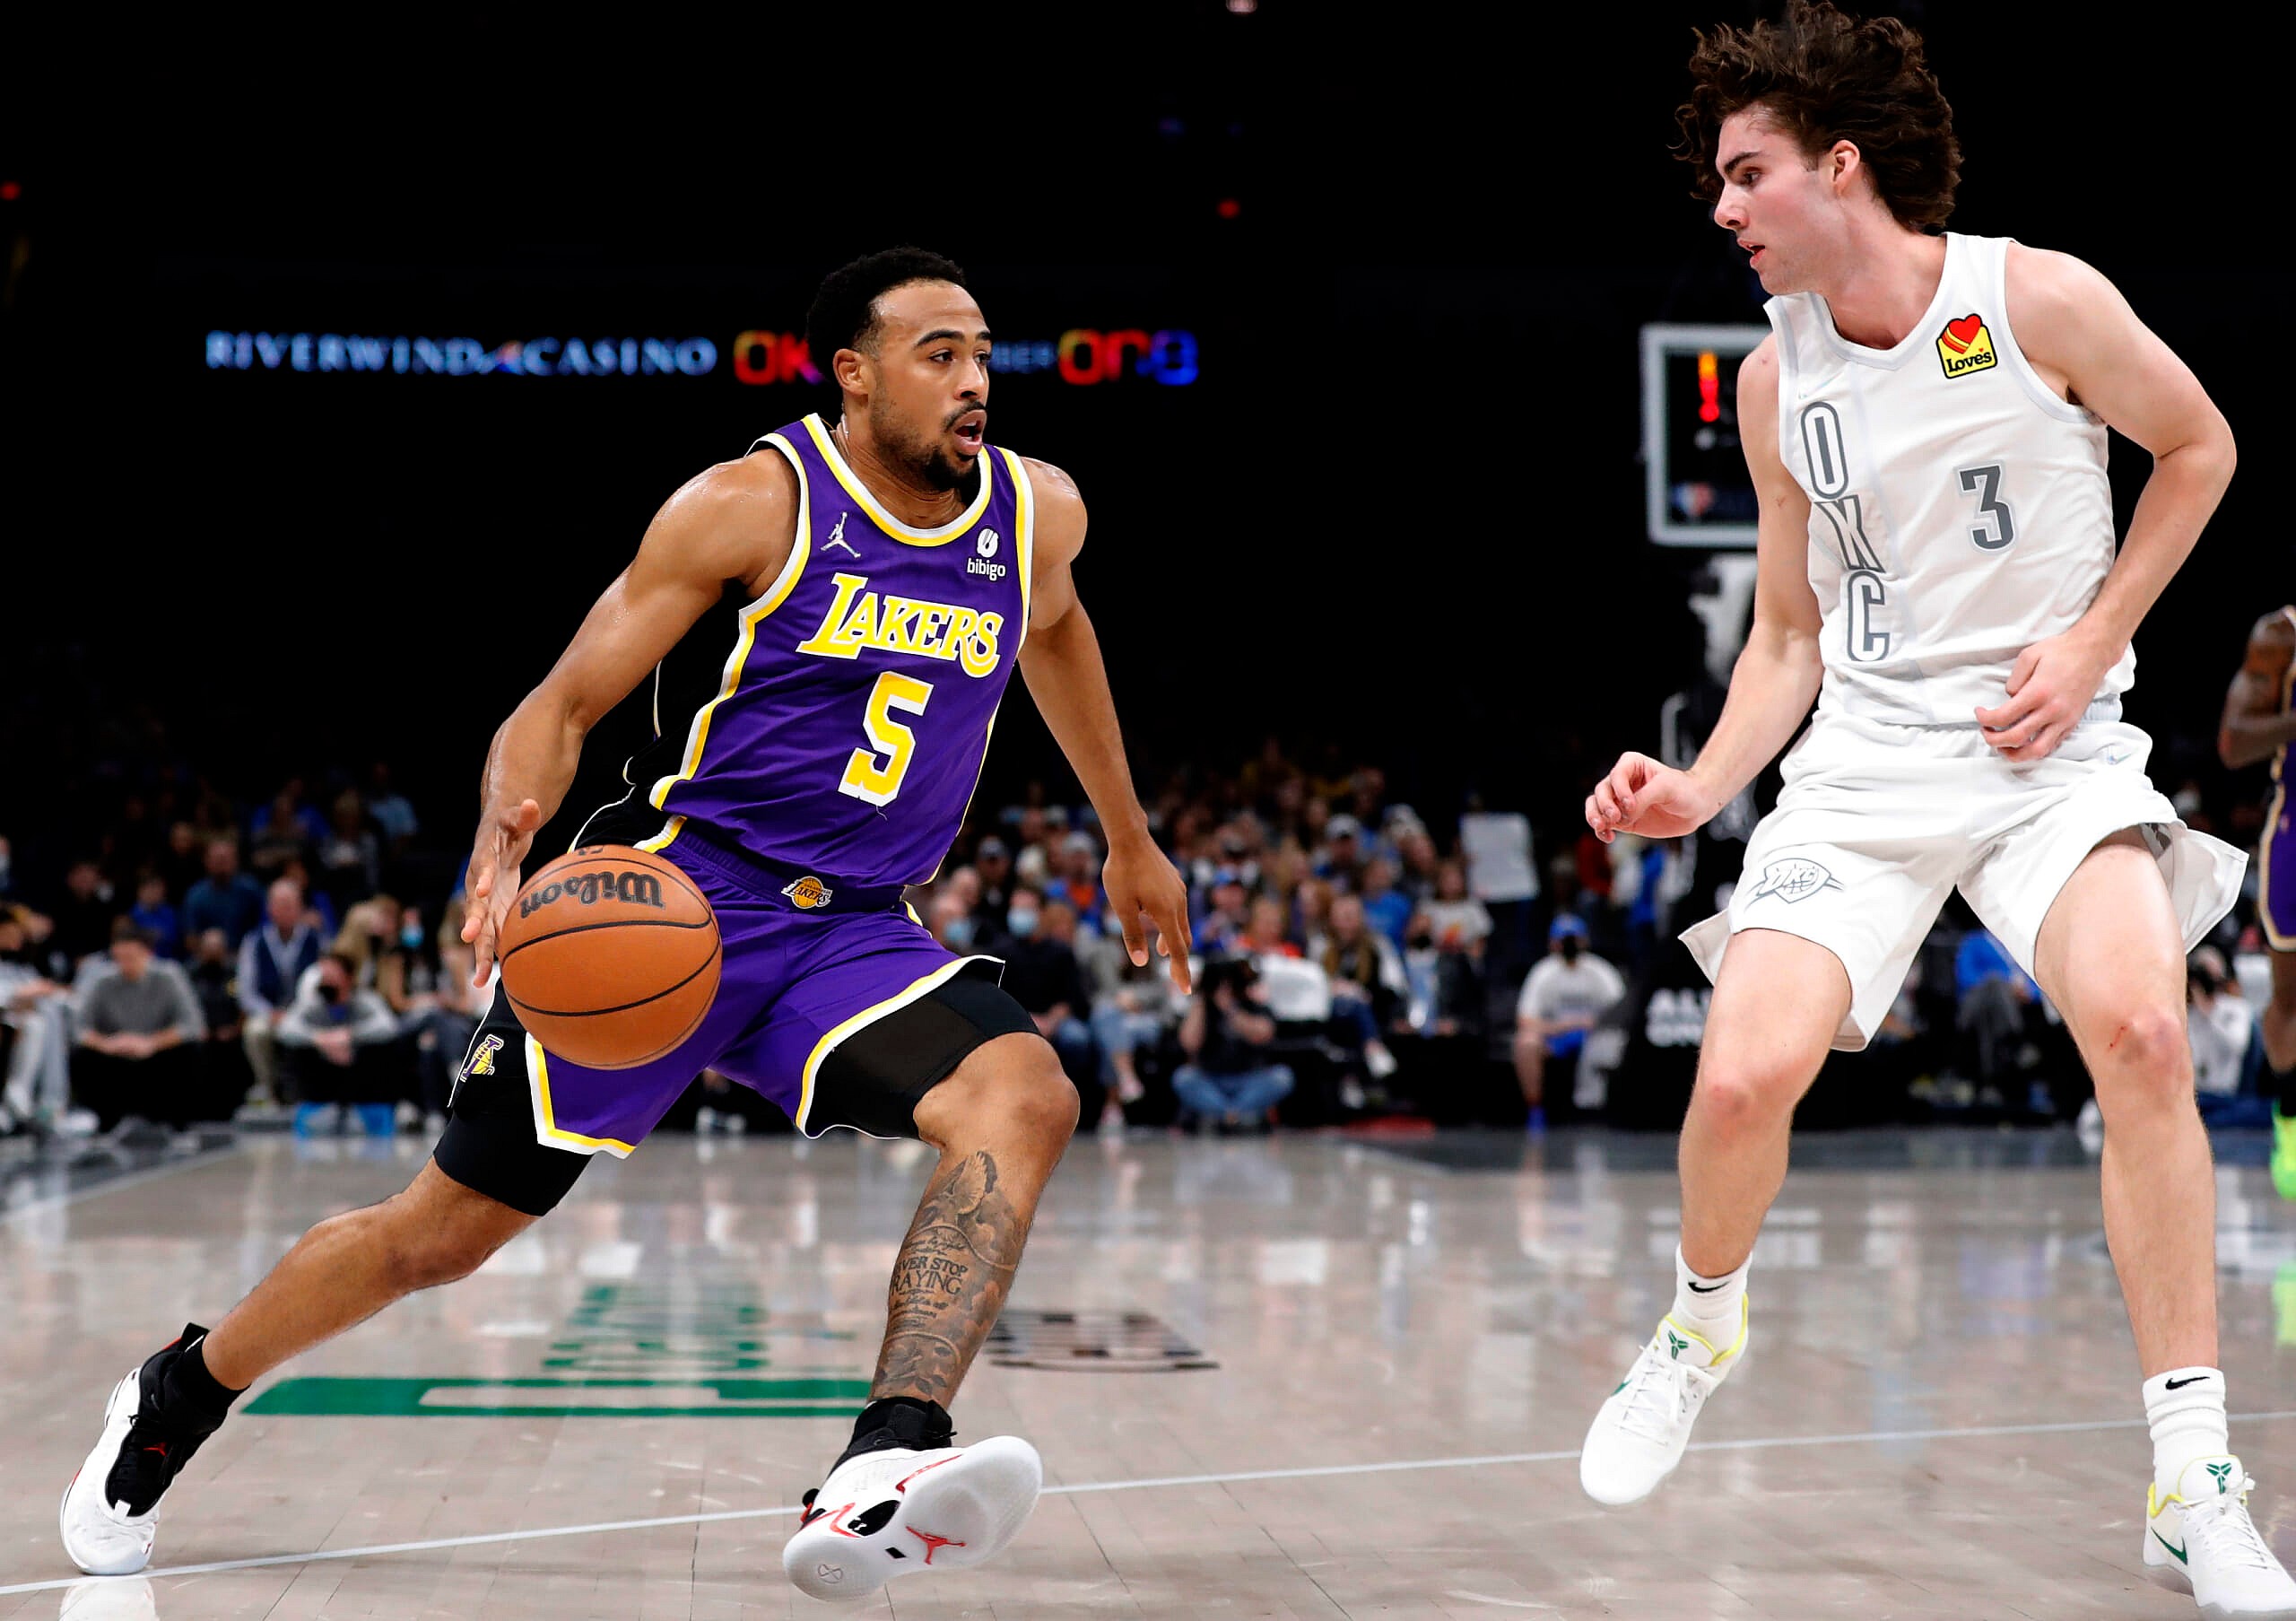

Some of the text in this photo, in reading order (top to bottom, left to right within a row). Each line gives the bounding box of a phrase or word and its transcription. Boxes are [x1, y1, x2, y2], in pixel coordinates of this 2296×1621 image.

[206, 331, 718, 376] RIVERWIND CASINO
[1957, 460, 2016, 553] 3
[967, 558, 1006, 581] bibigo
[796, 572, 1004, 678] LAKERS
[838, 671, 935, 807] 5
[520, 871, 665, 919] Wilson
[930, 1257, 969, 1277] STOP
